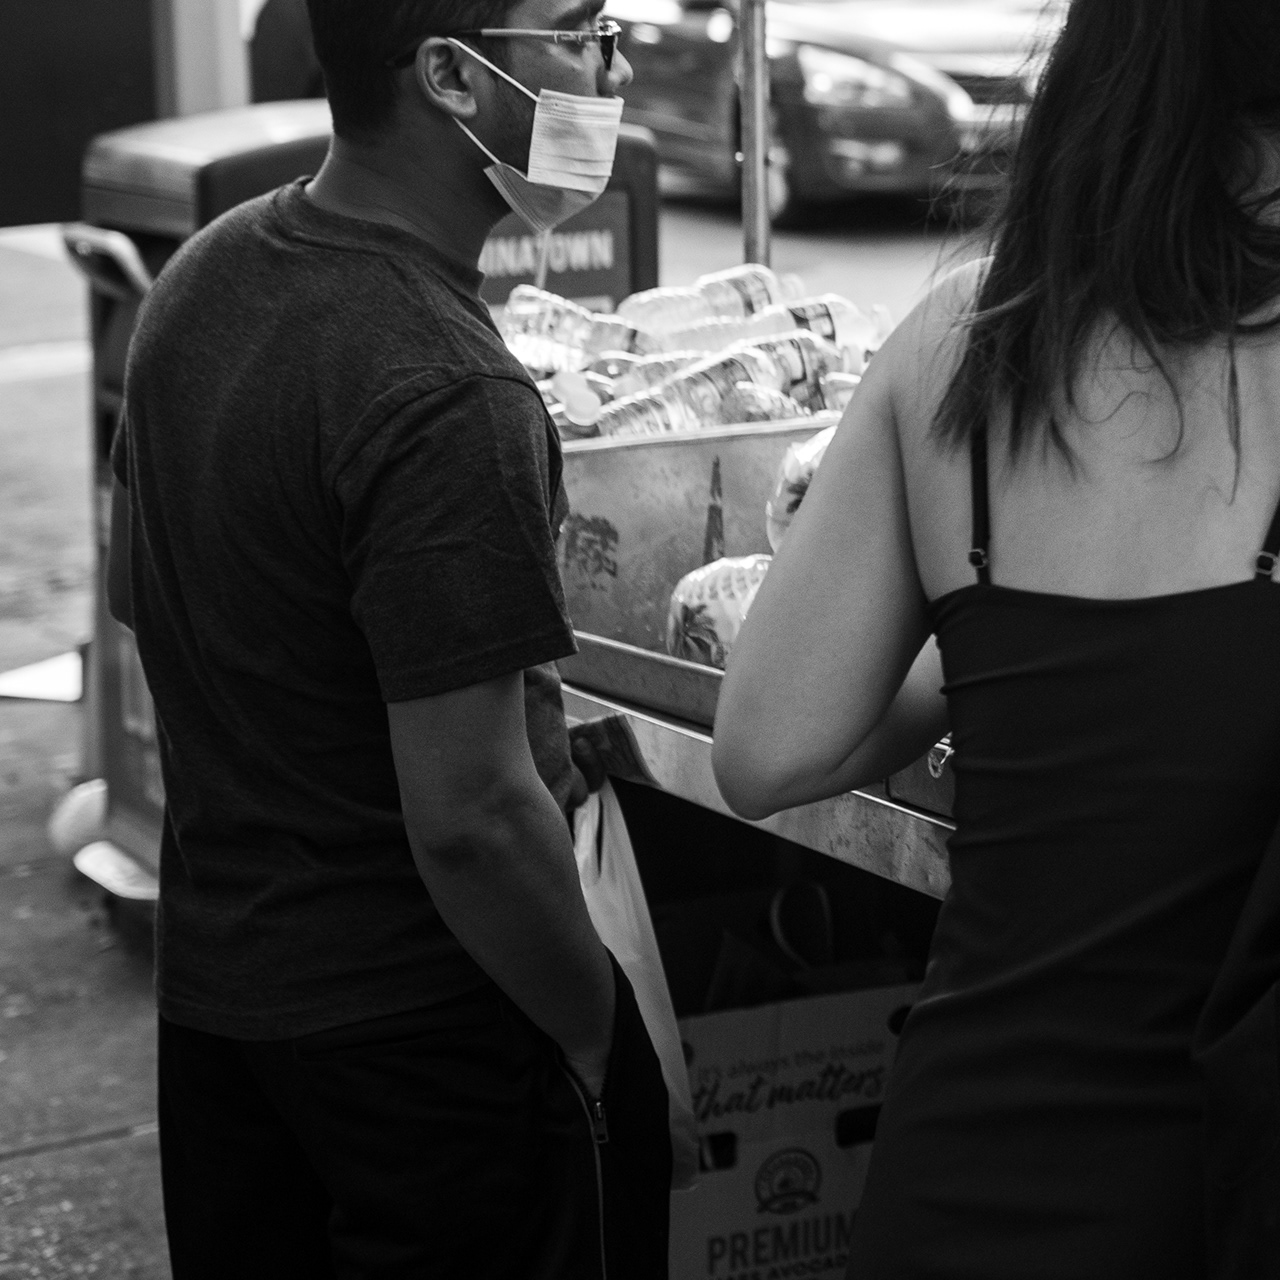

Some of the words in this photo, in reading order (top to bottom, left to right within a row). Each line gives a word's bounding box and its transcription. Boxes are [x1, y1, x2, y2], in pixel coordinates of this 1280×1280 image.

[478, 229, 614, 278] INATOWN
[692, 1076, 766, 1123] that
[766, 1063, 885, 1110] matters
[767, 1253, 849, 1280] AVOCAD
